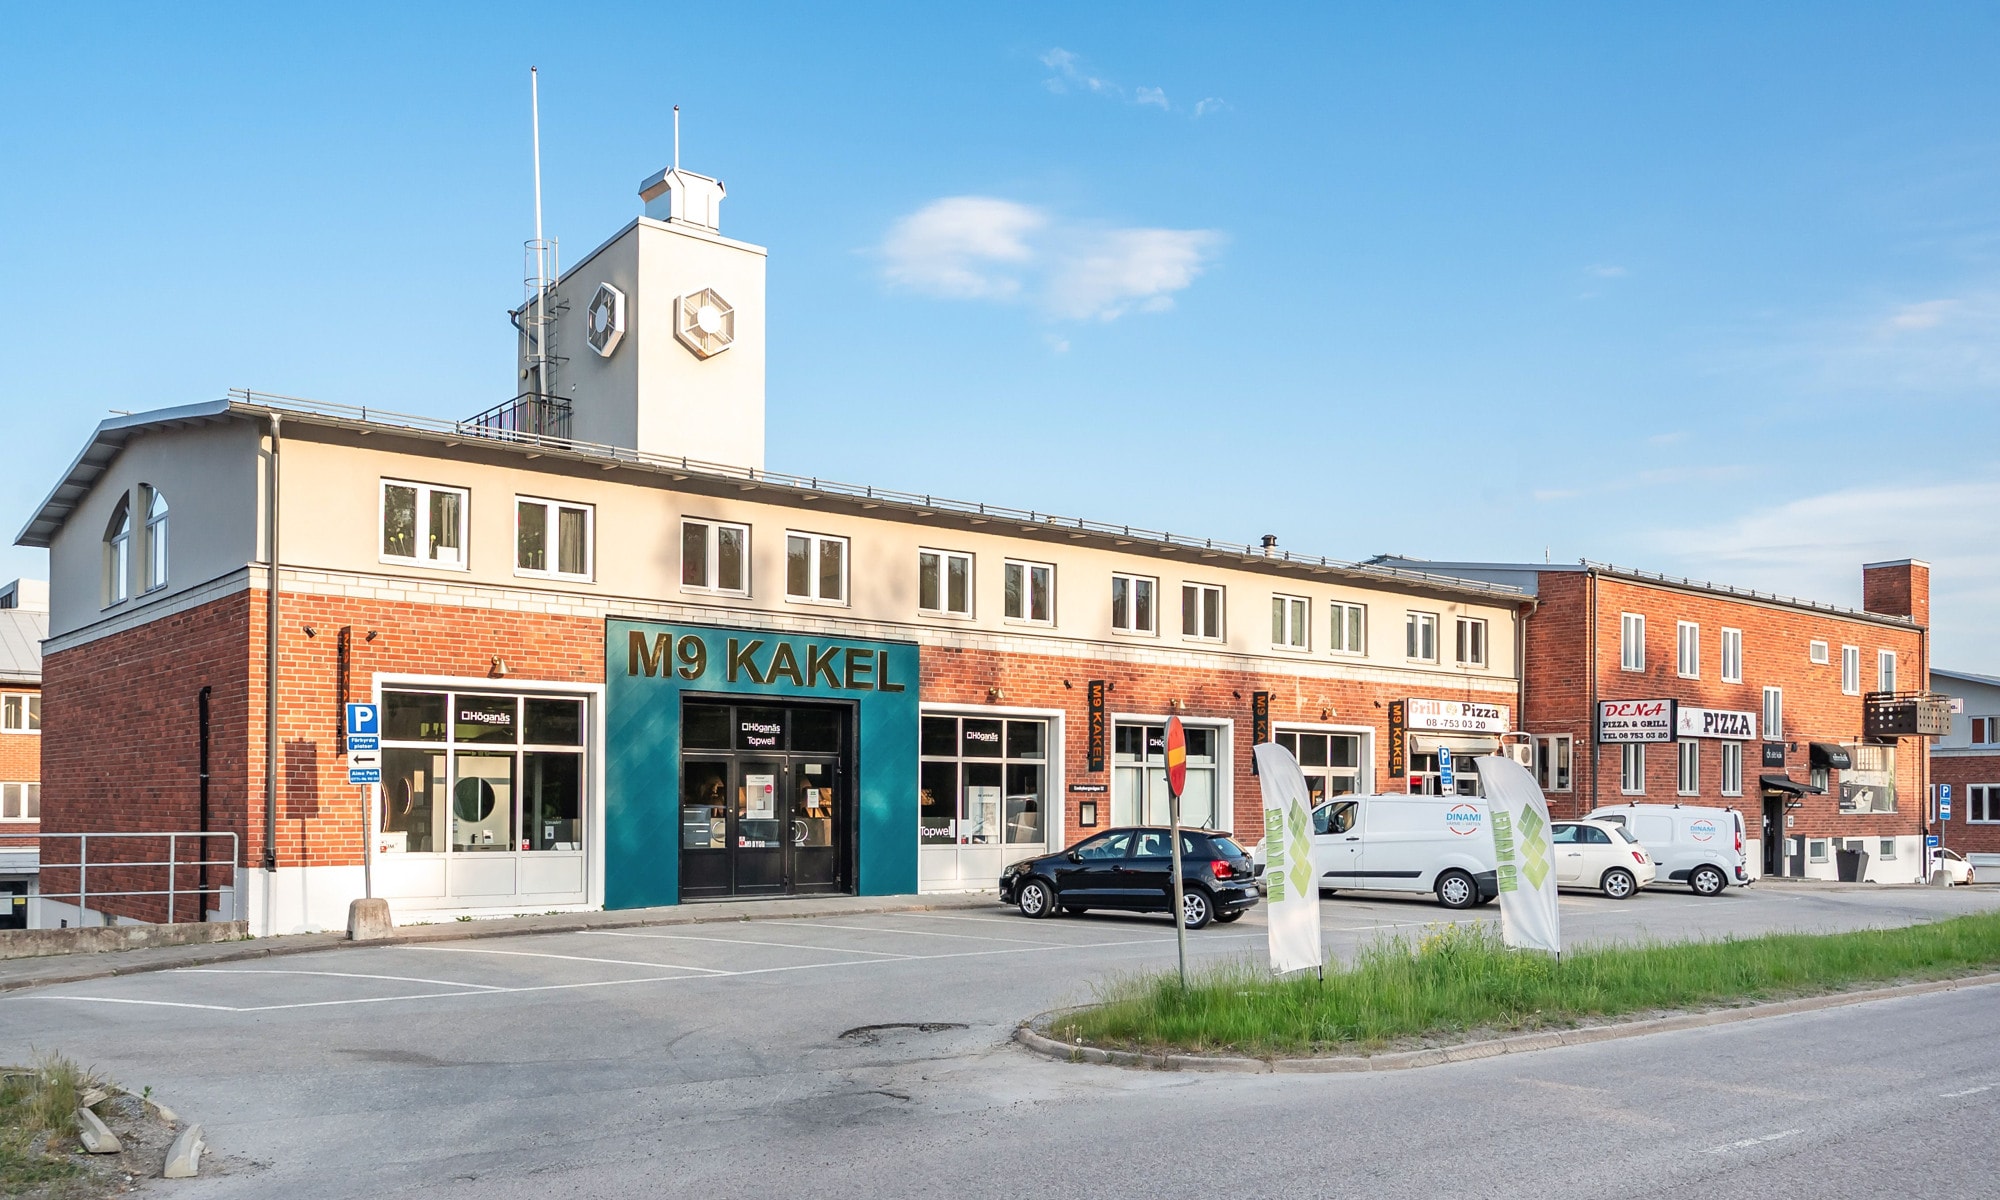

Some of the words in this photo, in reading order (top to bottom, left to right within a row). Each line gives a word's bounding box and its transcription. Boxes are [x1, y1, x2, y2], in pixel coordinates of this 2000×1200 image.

[628, 630, 707, 680] M9
[727, 637, 905, 692] KAKEL
[1093, 685, 1102, 707] M9
[1257, 695, 1266, 716] M9
[1409, 701, 1440, 715] Grill
[1462, 703, 1499, 718] Pizza
[1604, 703, 1666, 717] DENA
[354, 706, 373, 732] P
[470, 711, 511, 723] Höganäs
[1392, 704, 1403, 724] M9
[749, 722, 781, 733] Höganäs
[1426, 718, 1437, 727] 08
[1440, 719, 1459, 728] -753
[1462, 720, 1473, 728] 03
[1475, 721, 1486, 729] 20
[1602, 720, 1629, 728] PIZZA
[1640, 720, 1668, 728] GRILL
[1703, 712, 1751, 735] PIZZA
[747, 736, 776, 747] Topwell
[1093, 711, 1102, 767] KAKEL
[1392, 727, 1403, 774] KAKEL
[1441, 749, 1449, 765] P
[1942, 786, 1949, 797] P
[1446, 813, 1482, 821] DINAMI
